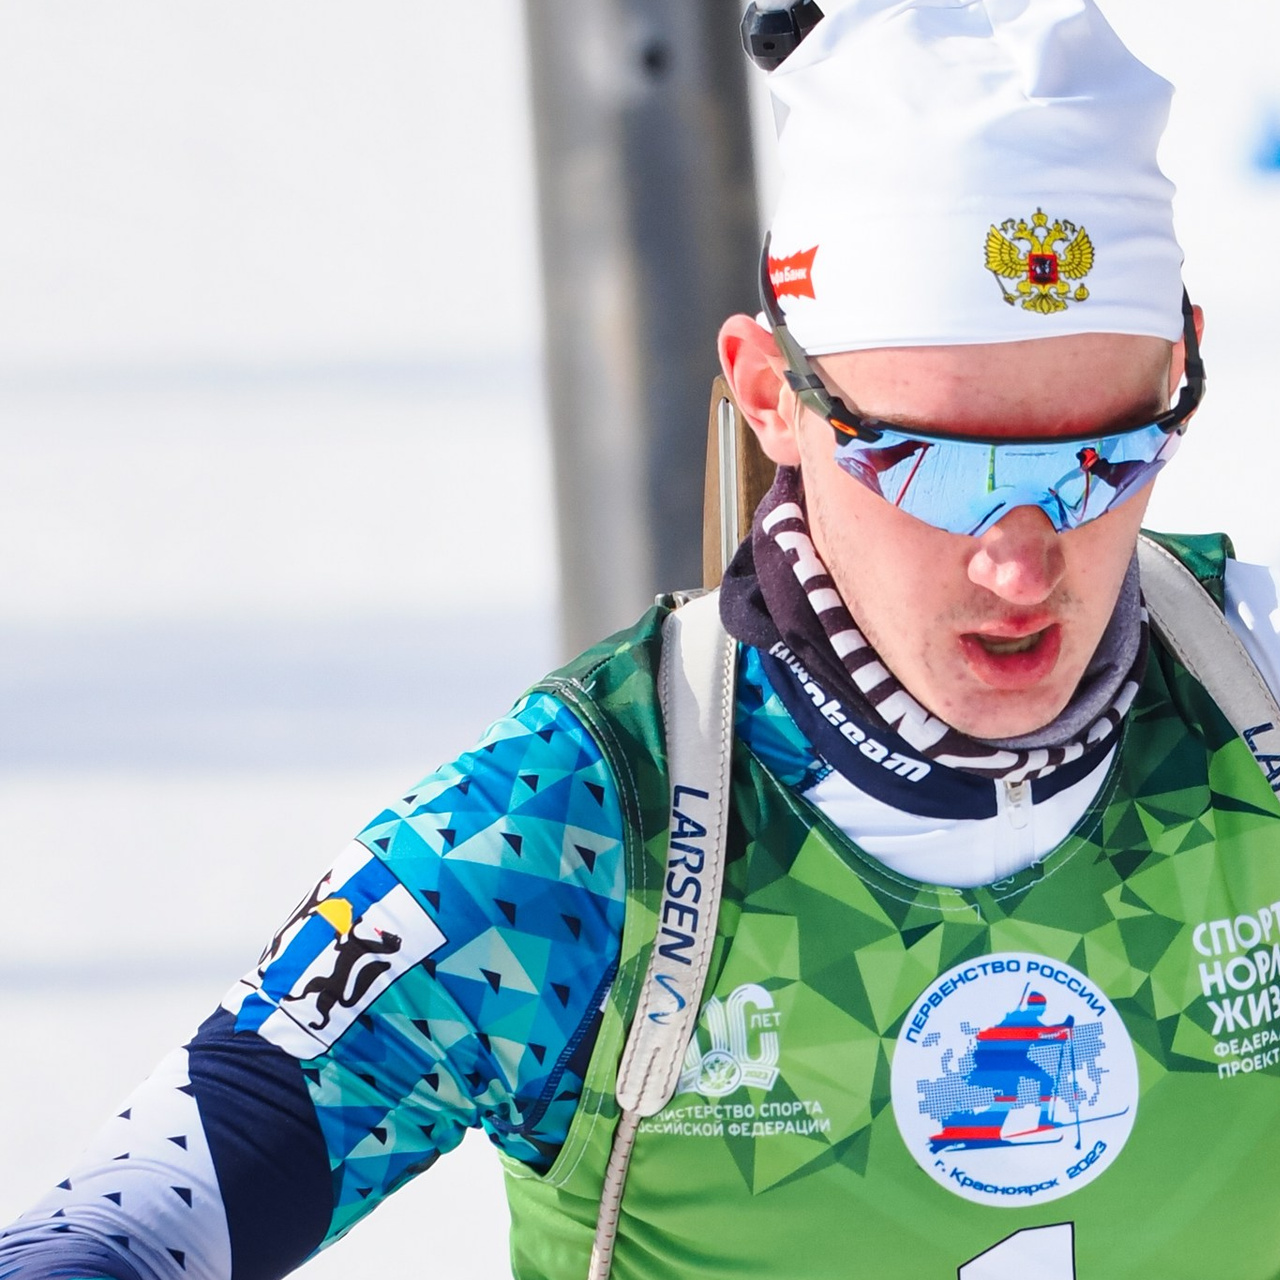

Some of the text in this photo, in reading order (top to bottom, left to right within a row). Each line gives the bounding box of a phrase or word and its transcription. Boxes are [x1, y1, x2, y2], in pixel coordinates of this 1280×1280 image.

[657, 784, 710, 967] LARSEN
[905, 959, 1106, 1044] ПЕРВЕНСТВО РОССИИ
[750, 1012, 782, 1029] ЛЕТ
[1217, 1047, 1280, 1080] ПРОЕКТ
[759, 1100, 823, 1118] СПОРТА
[728, 1118, 831, 1138] ФЕДЕРАЦИИ
[950, 1167, 1060, 1196] Красноярск
[1066, 1140, 1108, 1180] 2023
